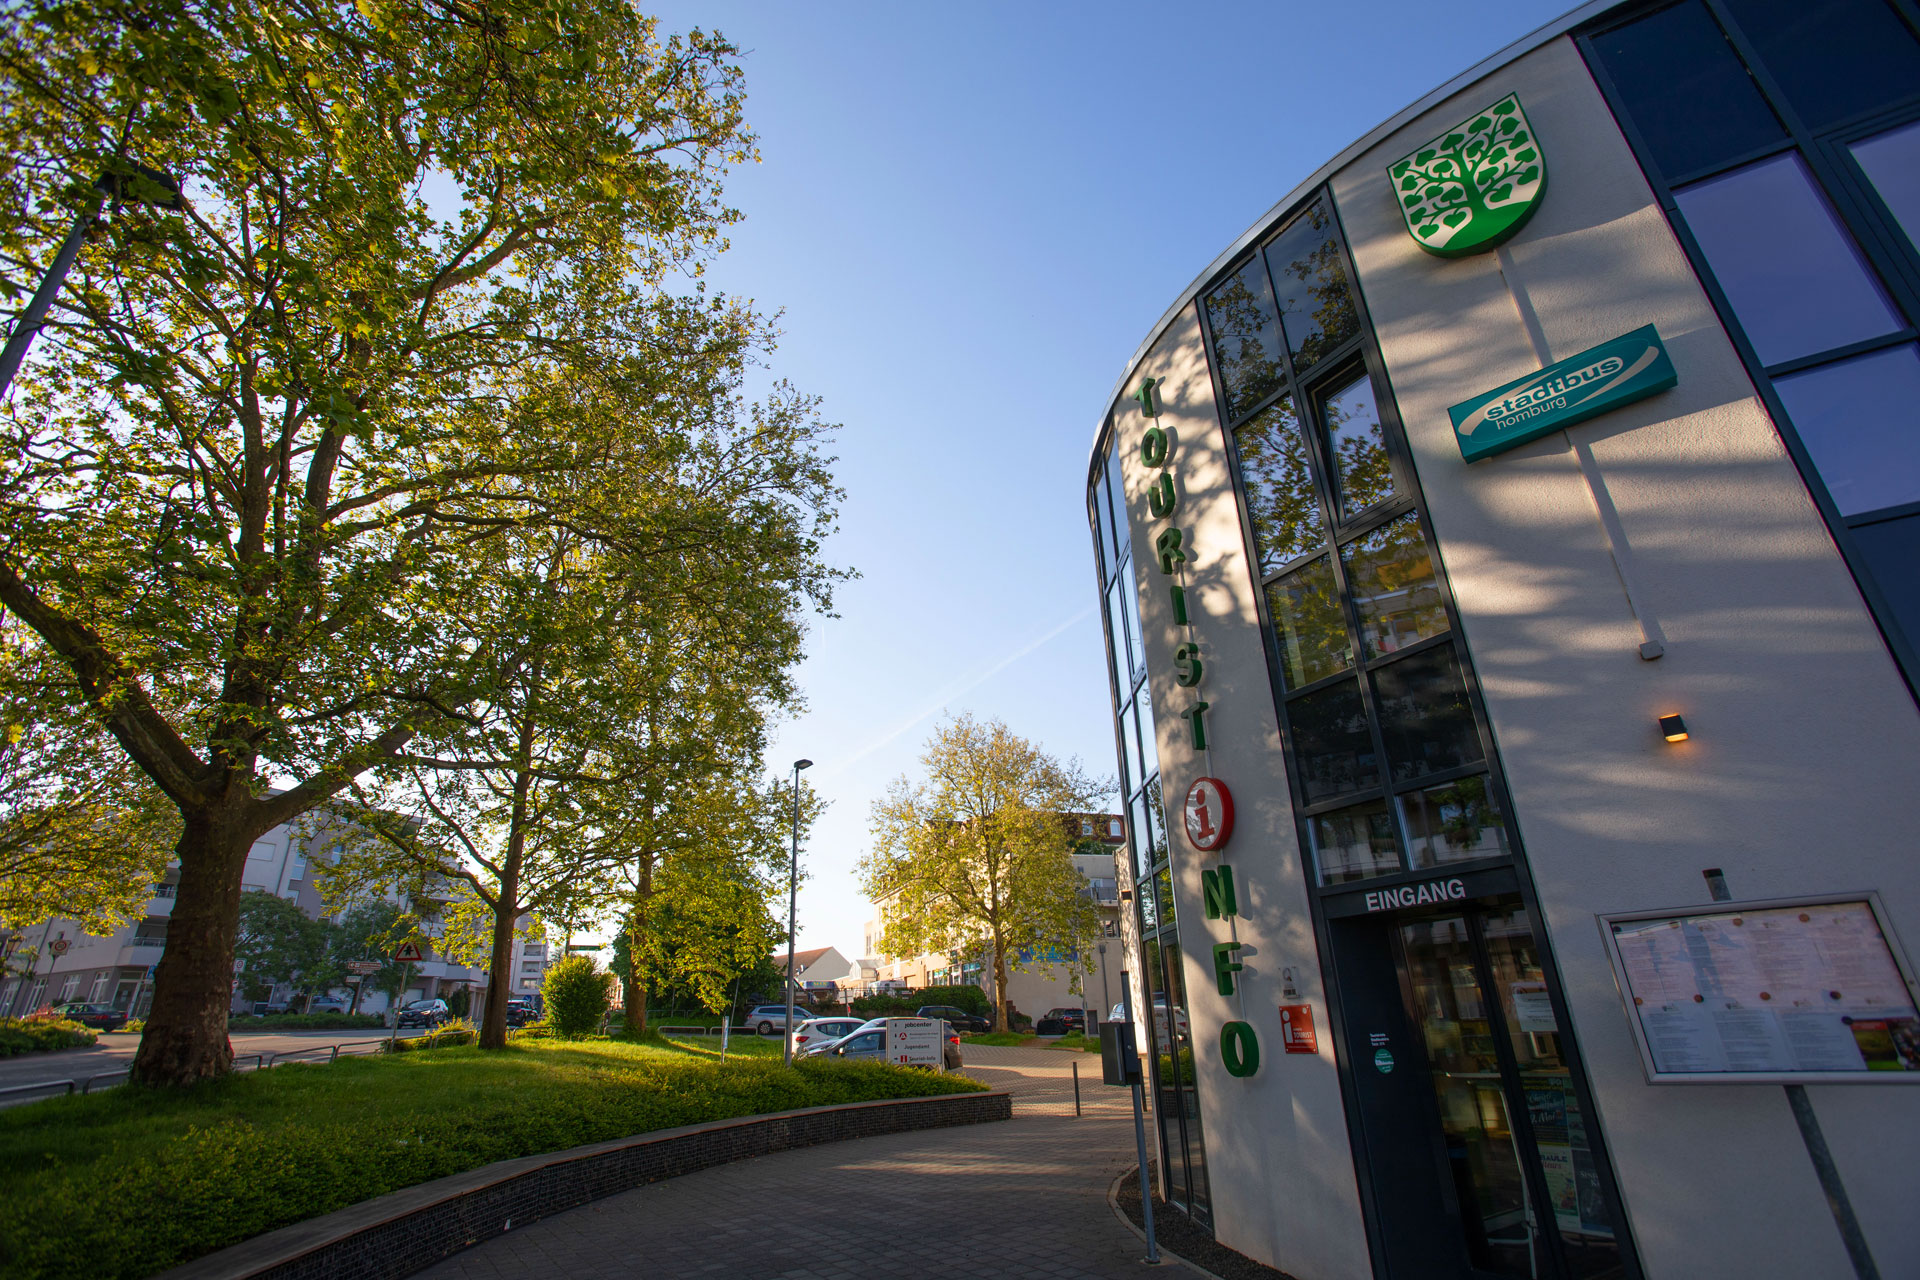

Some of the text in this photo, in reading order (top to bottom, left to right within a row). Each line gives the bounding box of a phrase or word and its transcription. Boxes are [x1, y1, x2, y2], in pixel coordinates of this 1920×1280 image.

[1486, 357, 1621, 419] stadtbus
[1496, 396, 1567, 430] homburg
[1133, 377, 1209, 751] TOURIST
[1365, 878, 1467, 912] EINGANG
[904, 1021, 932, 1029] jobcenter
